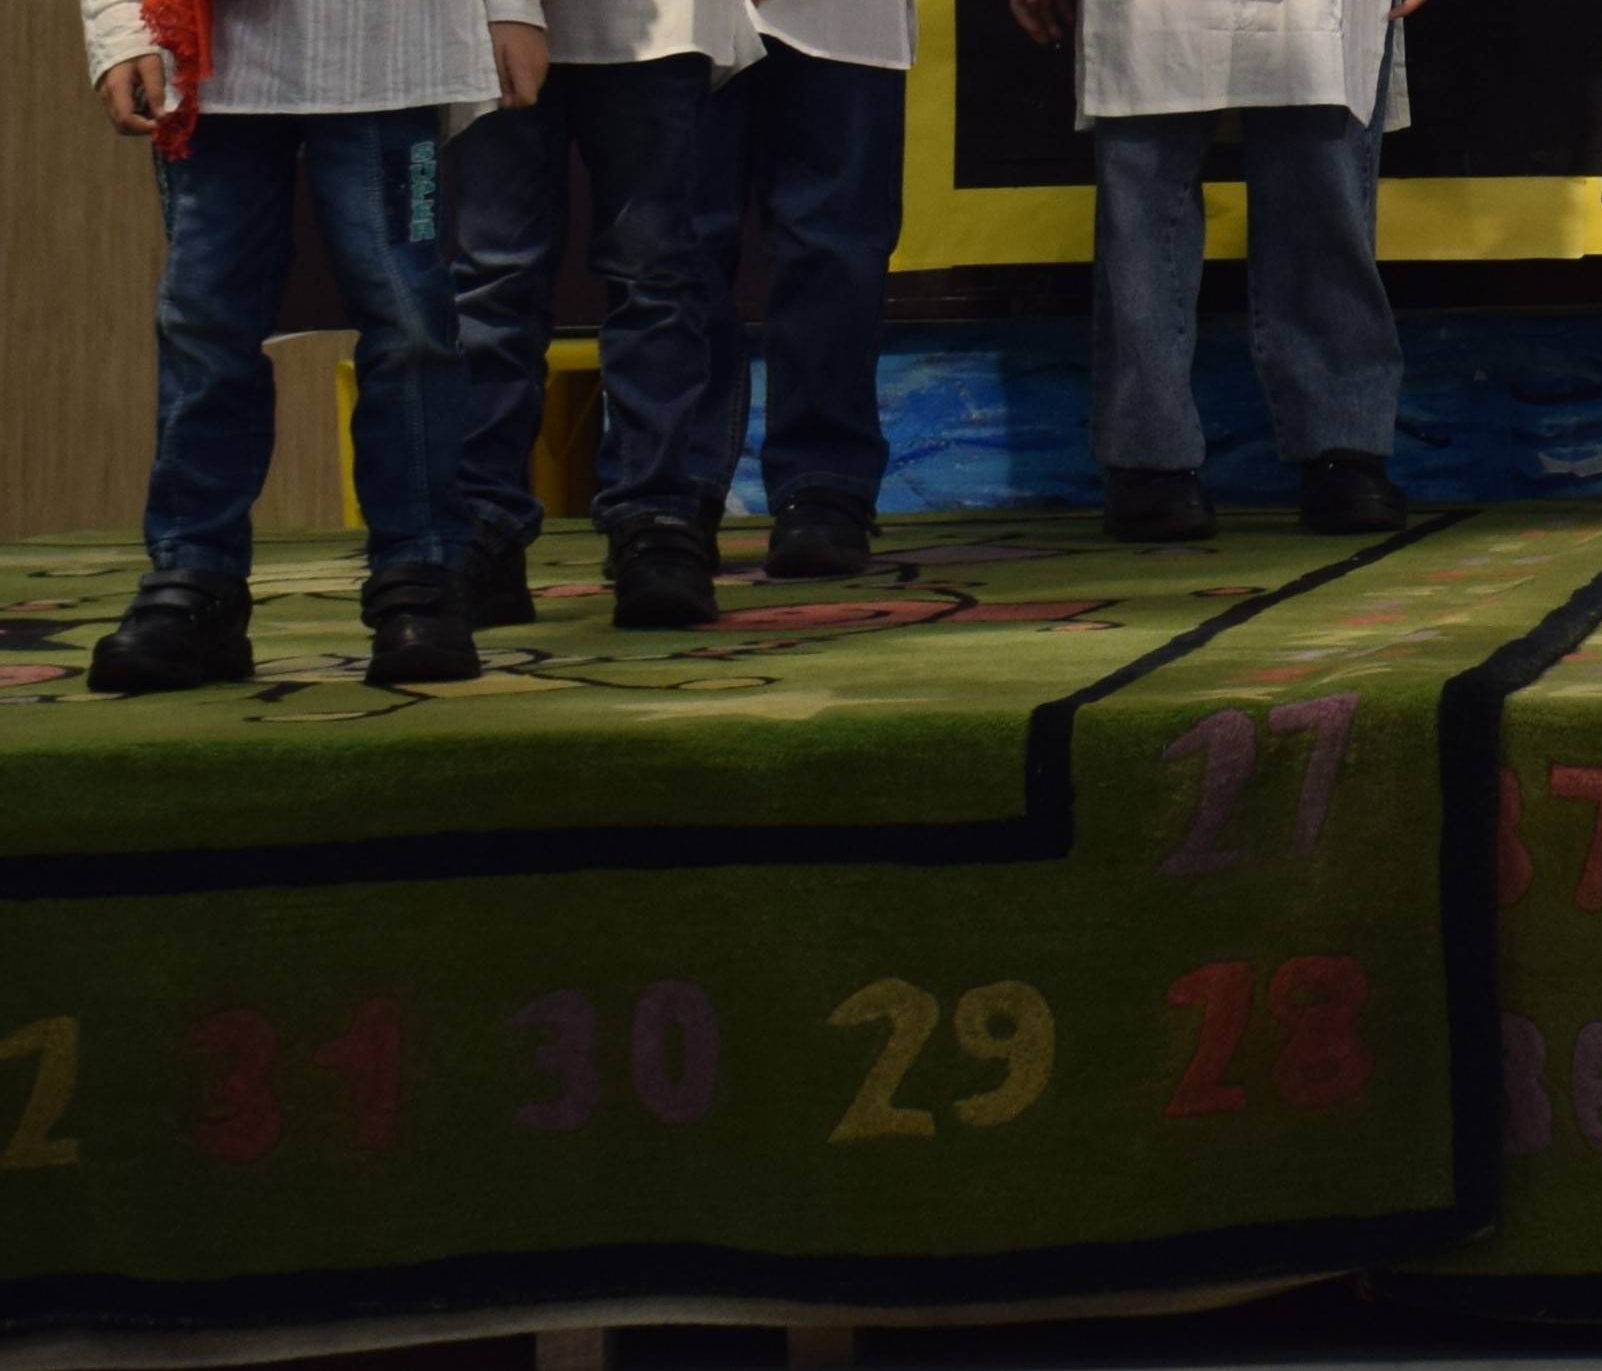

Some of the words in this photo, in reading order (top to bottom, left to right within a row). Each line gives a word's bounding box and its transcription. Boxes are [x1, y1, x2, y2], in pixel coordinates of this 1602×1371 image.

[1157, 692, 1361, 876] 27
[190, 996, 407, 1162] 31
[508, 980, 721, 1133] 30
[828, 977, 1055, 1143] 29
[1164, 954, 1375, 1118] 28
